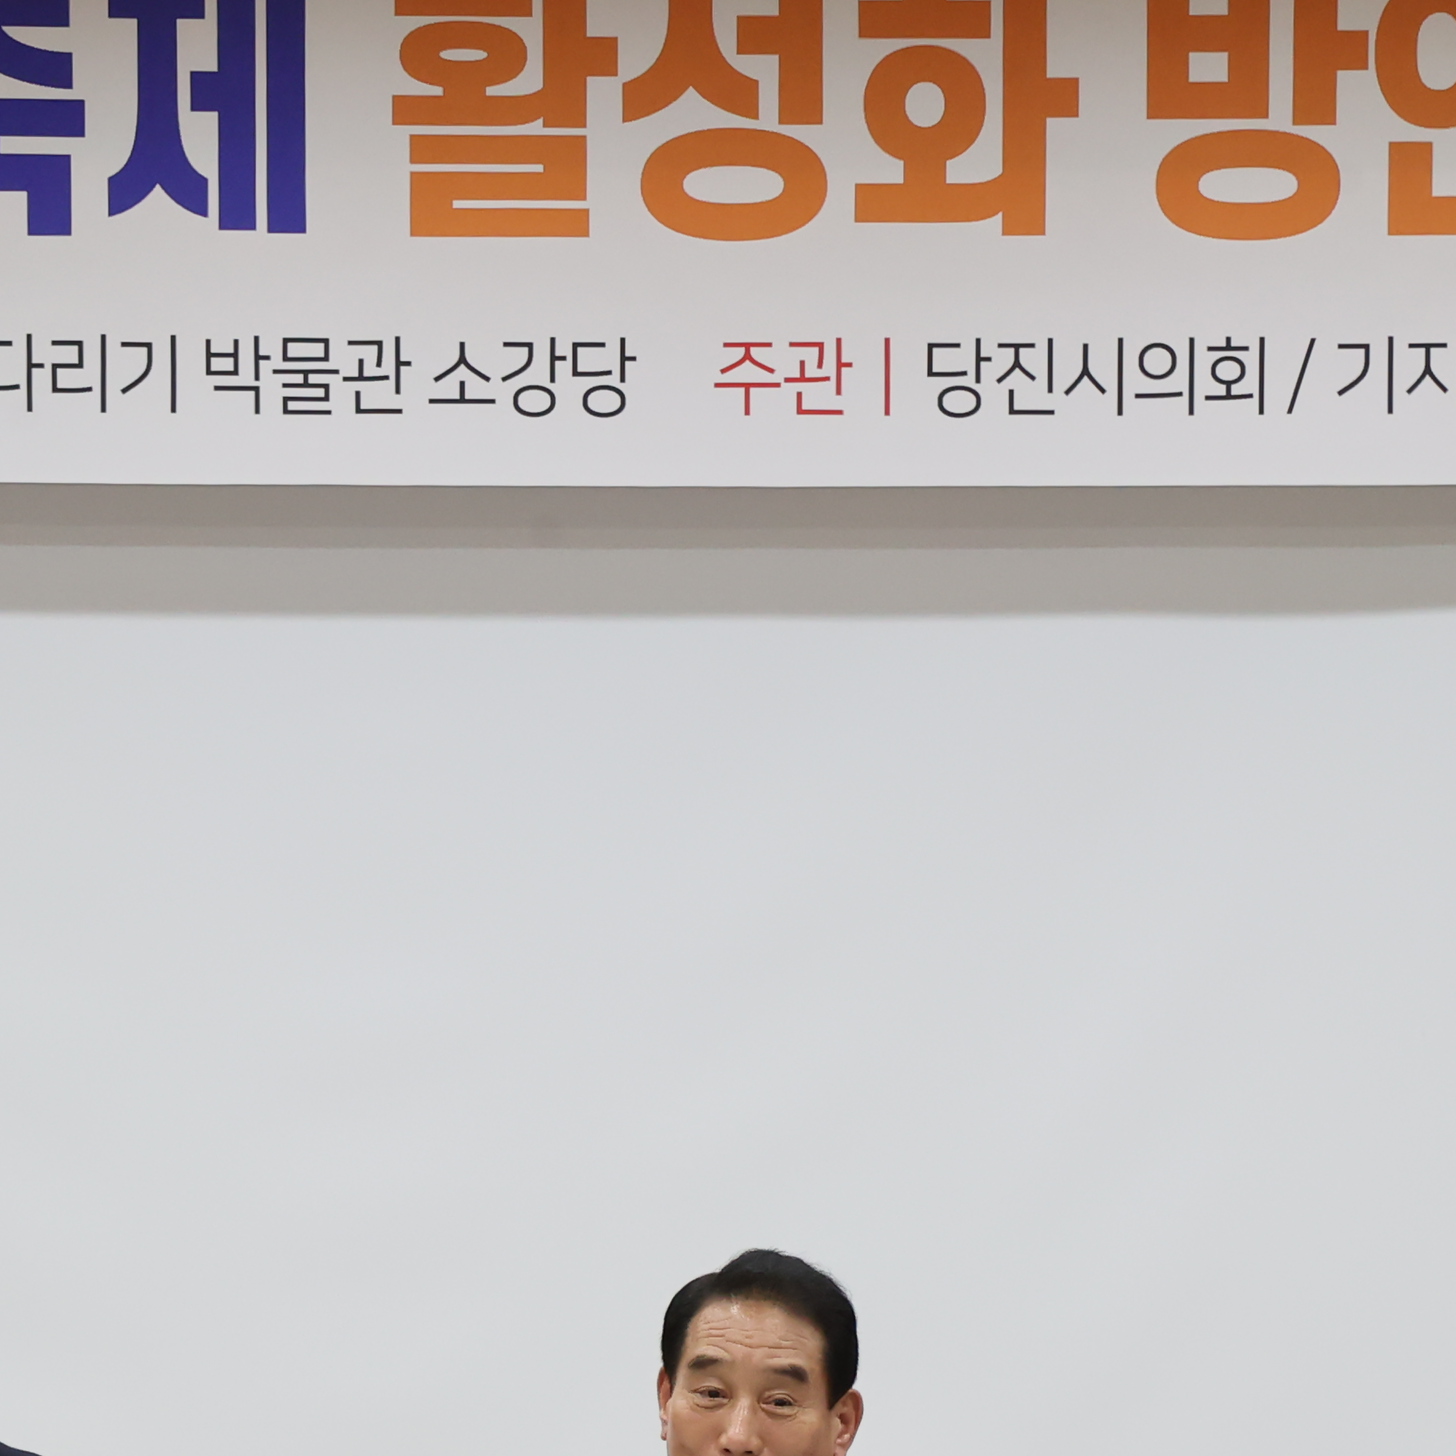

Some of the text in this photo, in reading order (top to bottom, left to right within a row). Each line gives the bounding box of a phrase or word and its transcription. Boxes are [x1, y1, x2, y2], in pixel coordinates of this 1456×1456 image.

[393, 0, 1080, 242] 활성화
[206, 336, 413, 417] 박물관
[429, 337, 638, 420] 소강당
[714, 338, 855, 418] 주관
[927, 336, 1267, 420] 당진시의회
